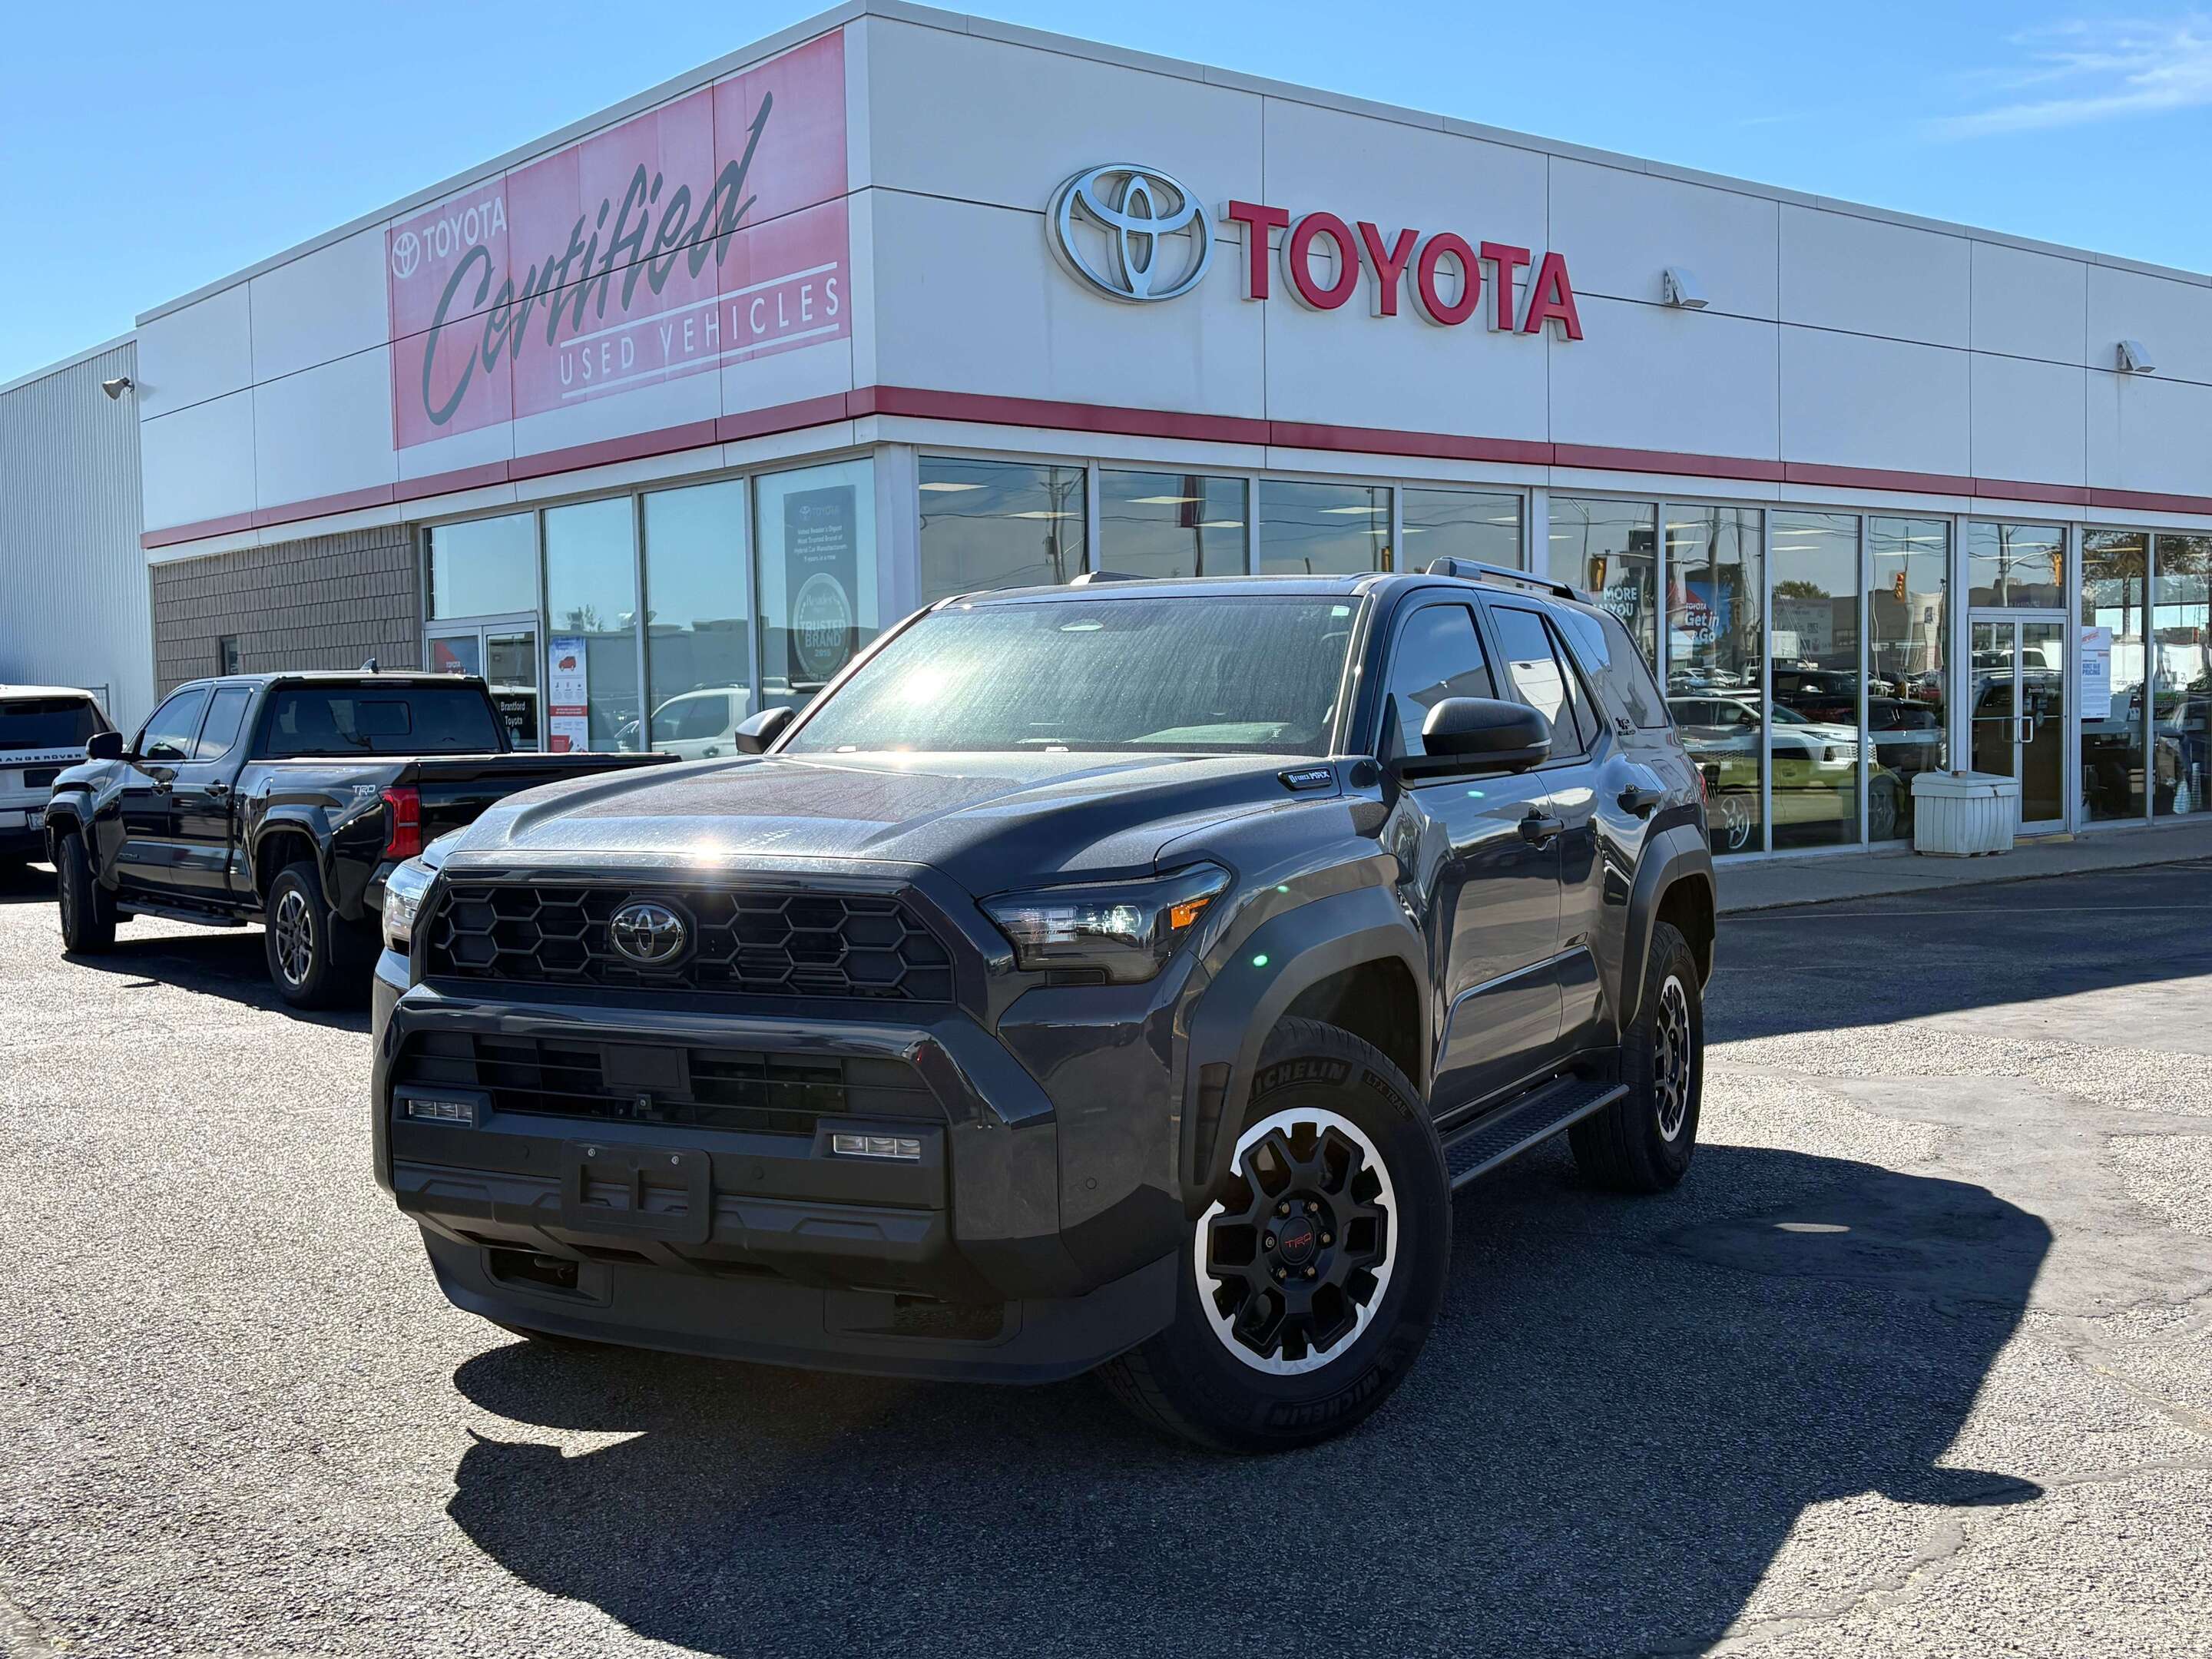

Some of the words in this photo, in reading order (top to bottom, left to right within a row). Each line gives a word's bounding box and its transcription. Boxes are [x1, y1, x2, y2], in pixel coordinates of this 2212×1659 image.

[423, 197, 508, 263] TOYOTA
[422, 91, 773, 426] Certified
[1220, 199, 1584, 343] TOYOTA
[560, 338, 635, 385] USED
[659, 276, 839, 356] VEHICLES
[1603, 587, 1637, 601] MORE
[1609, 603, 1634, 615] YOU
[799, 619, 846, 636] TRUSTED
[1685, 611, 1707, 627] Get
[1708, 611, 1720, 627] in
[805, 630, 842, 647] BRAND
[1699, 630, 1716, 642] Go
[501, 701, 526, 711] Brantford
[505, 716, 523, 727] Toyota
[1309, 771, 1330, 780] MAX
[352, 784, 376, 796] TRD
[1253, 1061, 1347, 1095] ICHELIN
[1366, 1074, 1385, 1093] LTX
[1385, 1091, 1408, 1117] TRAIL
[1284, 1231, 1312, 1248] TRD
